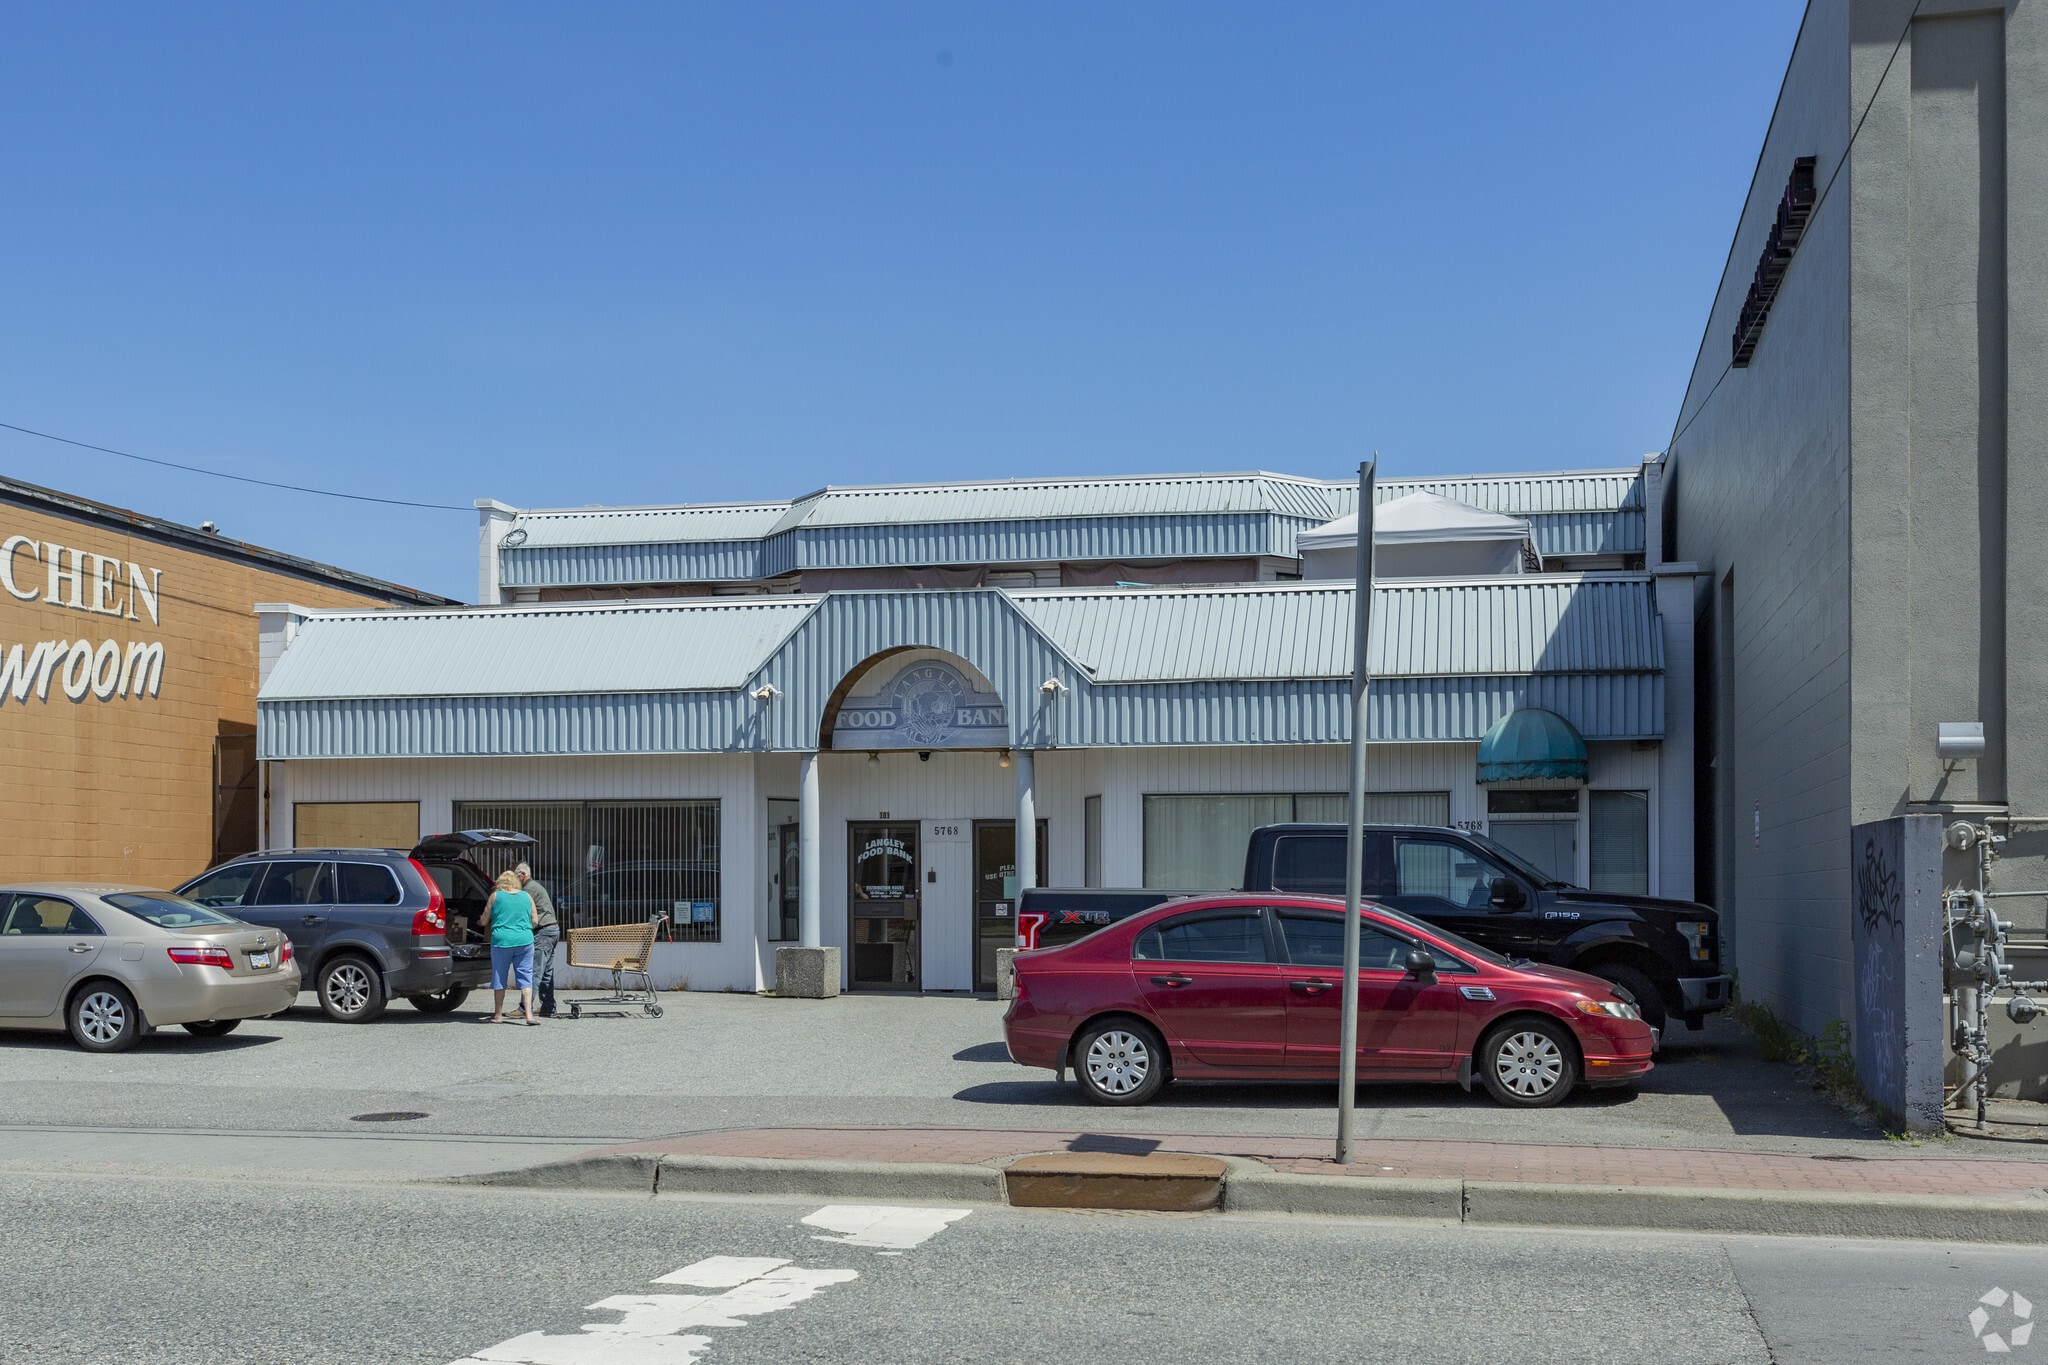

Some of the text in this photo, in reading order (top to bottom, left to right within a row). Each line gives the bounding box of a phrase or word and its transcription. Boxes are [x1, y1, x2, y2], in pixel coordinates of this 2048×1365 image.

[1, 534, 162, 626] CHEN
[0, 638, 163, 698] wroom
[894, 669, 964, 698] LANGLEY
[837, 710, 897, 728] FOOD
[934, 826, 959, 836] 5768
[865, 838, 905, 850] LANGLEY
[857, 847, 913, 864] FOOD BANK
[985, 872, 998, 880] USE
[999, 864, 1016, 872] PLEA
